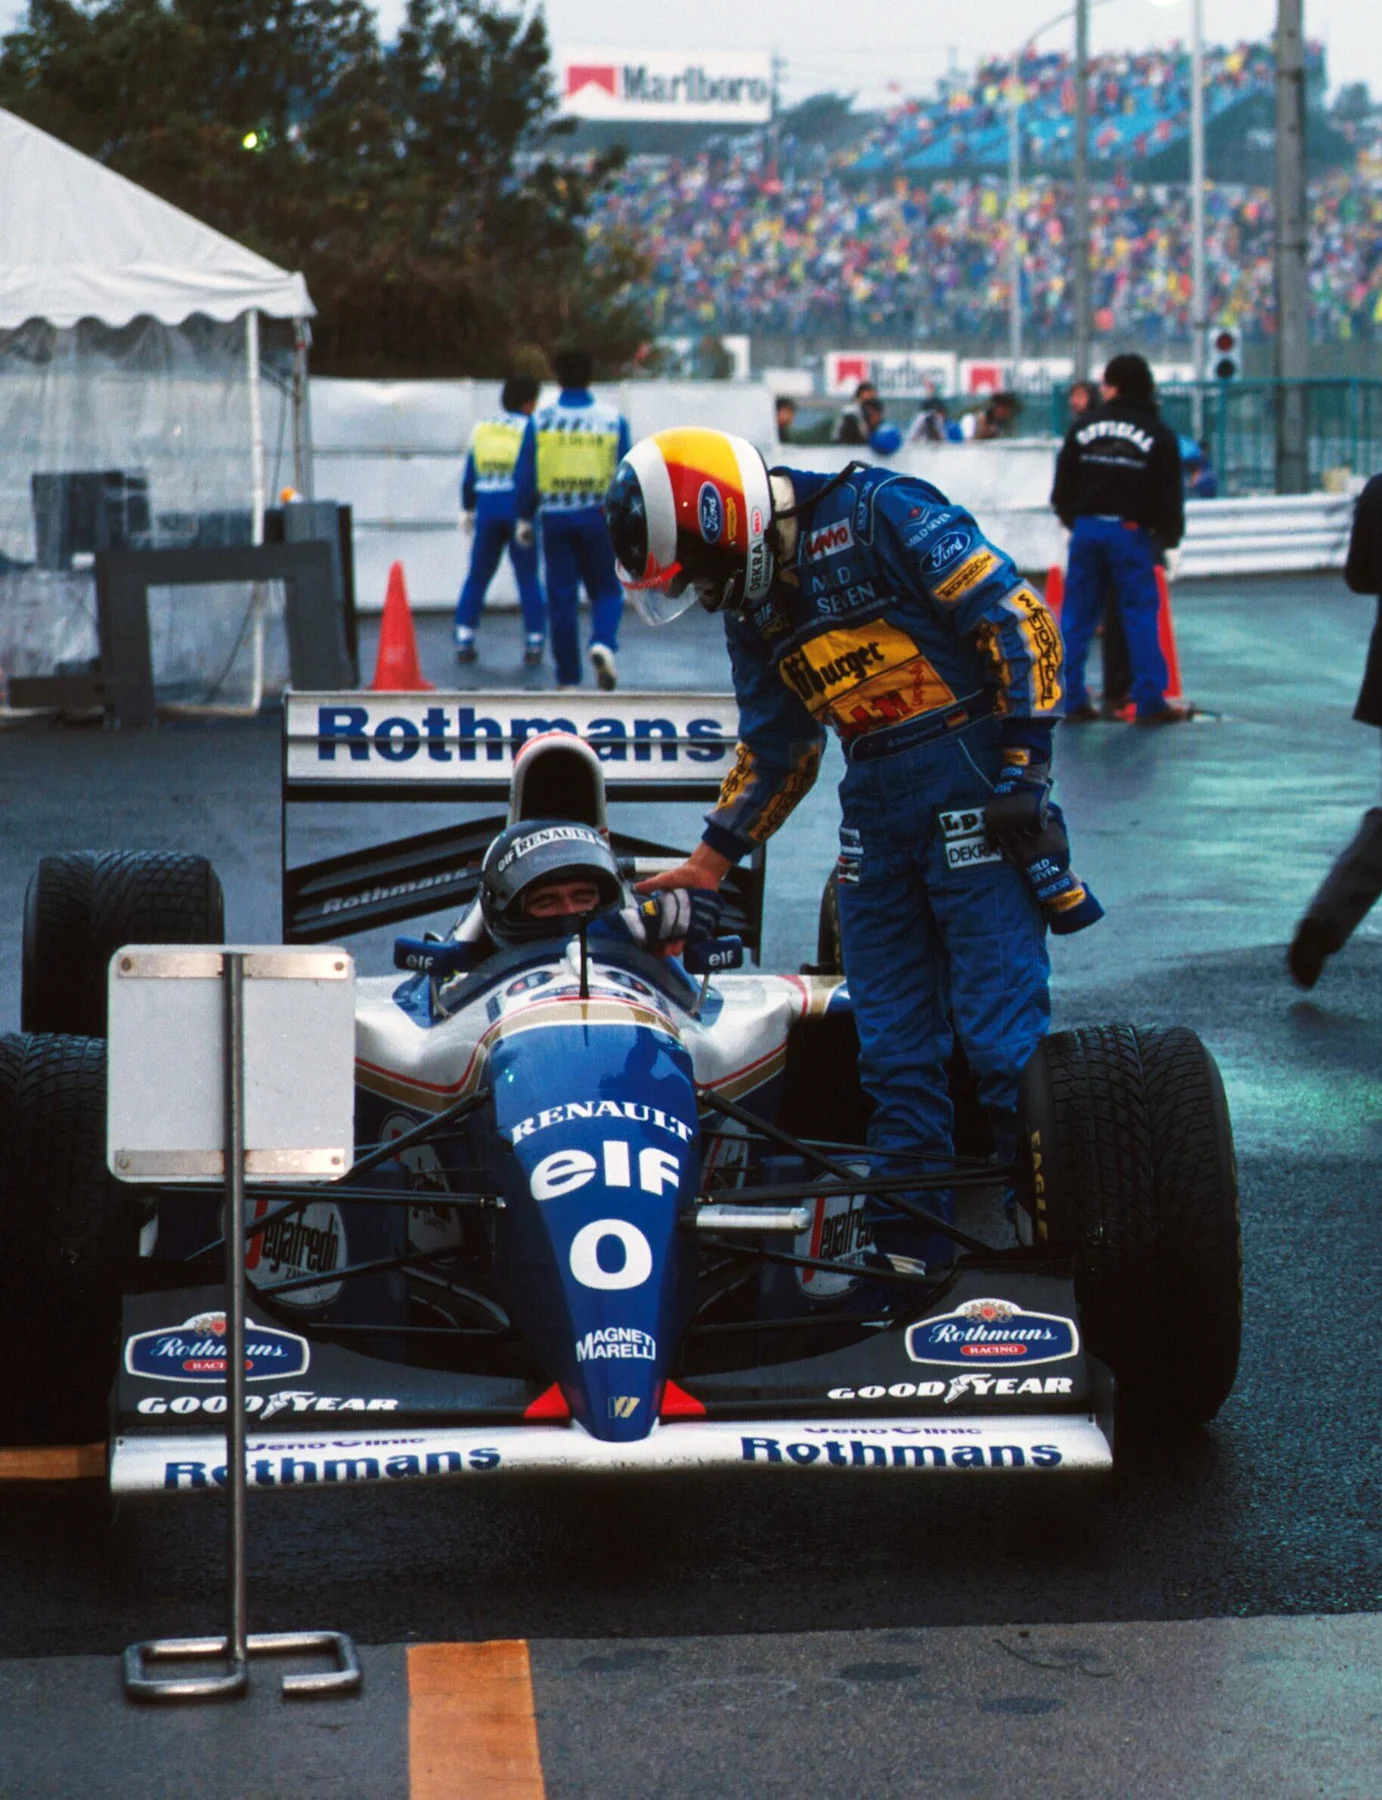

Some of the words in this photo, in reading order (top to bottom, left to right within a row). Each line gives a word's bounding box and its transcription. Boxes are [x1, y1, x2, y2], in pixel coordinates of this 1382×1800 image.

[622, 64, 767, 104] Marlboro
[1076, 420, 1154, 452] OFFICIAL
[703, 495, 719, 532] Ford
[931, 536, 964, 569] Ford
[498, 851, 515, 872] elf
[519, 827, 596, 853] RENAULT
[322, 866, 470, 915] Rothmans
[406, 954, 434, 971] elf
[709, 950, 735, 966] elf
[509, 1100, 693, 1146] RENAULT
[529, 1140, 680, 1201] elf
[569, 1218, 653, 1291] 0
[151, 1337, 289, 1359] Rothans
[928, 1323, 1059, 1343] Rothmans
[969, 1346, 1018, 1355] RACING
[740, 1436, 1063, 1468] Rothmans
